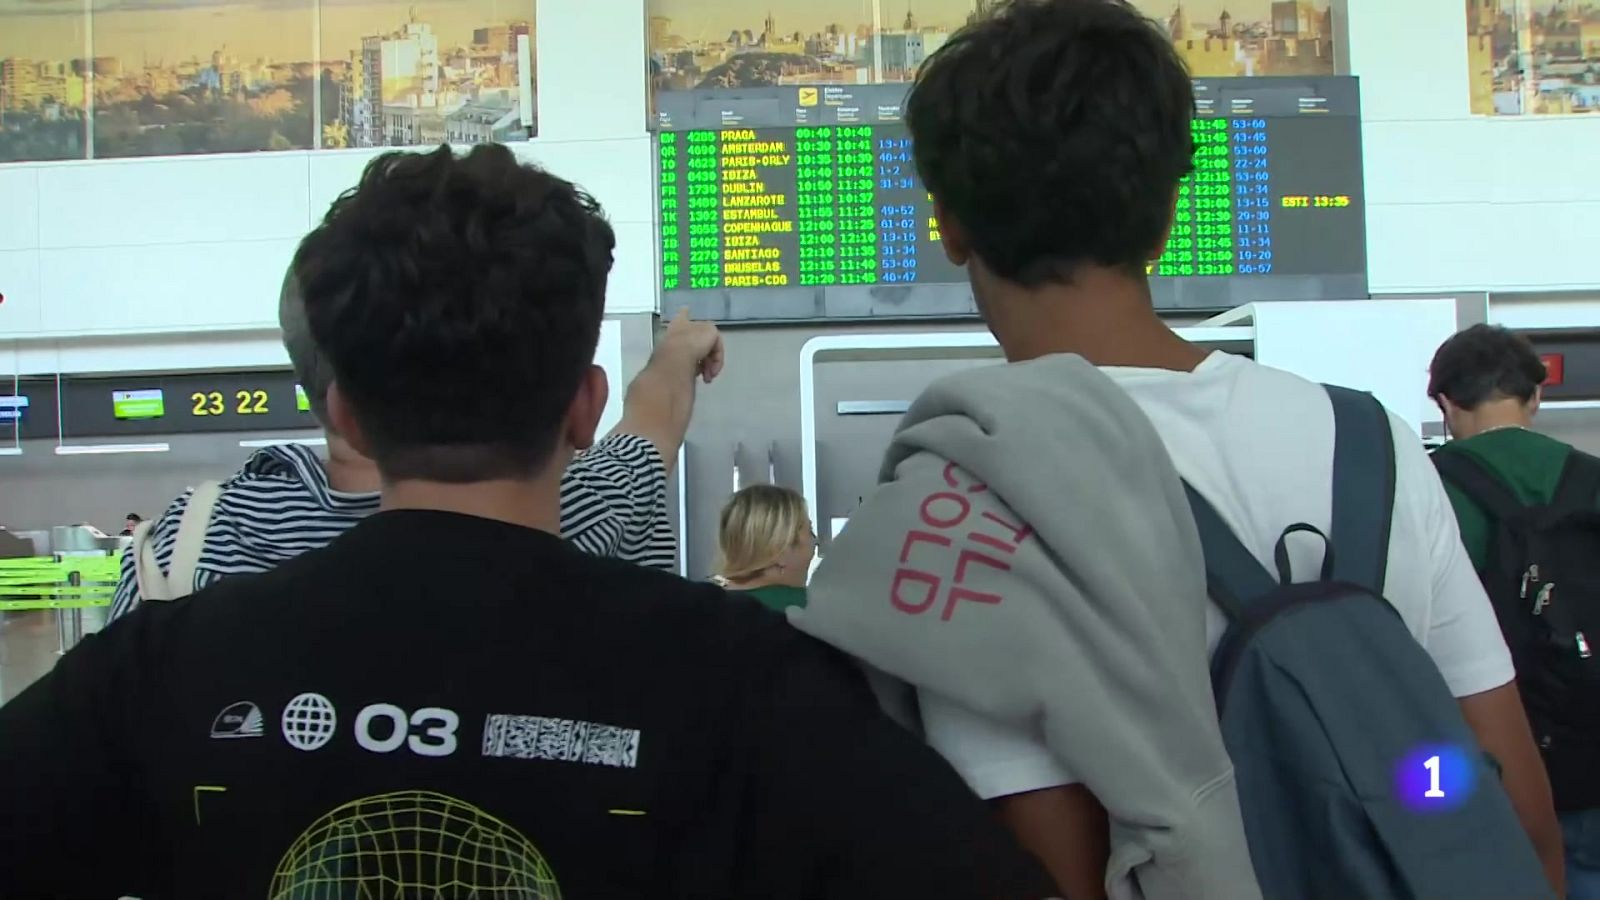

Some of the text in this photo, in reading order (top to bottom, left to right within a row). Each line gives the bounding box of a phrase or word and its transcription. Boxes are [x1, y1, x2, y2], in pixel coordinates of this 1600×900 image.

[1191, 119, 1227, 130] 11:45
[721, 130, 755, 141] PRAGA
[836, 126, 871, 137] 10:40
[661, 146, 676, 157] QR
[722, 142, 784, 154] AMSTERDAM
[796, 141, 831, 151] 10:30
[836, 140, 871, 150] 10:41
[662, 159, 675, 169] TO
[722, 156, 790, 167] PARIS-ORLY
[722, 170, 756, 180] IBIZA
[797, 167, 831, 178] 10:40
[838, 166, 872, 177] 10:42
[880, 166, 900, 175] 1-2
[1195, 172, 1230, 182] 12:15
[662, 186, 676, 196] FR
[722, 182, 763, 193] DUBLIN
[1195, 184, 1229, 195] 12:20
[662, 199, 677, 209] FR
[723, 195, 784, 207] LANZAROTE
[798, 193, 832, 204] 11:10
[838, 193, 873, 203] 10:37
[1195, 198, 1230, 208] 13:00
[1237, 198, 1269, 207] 13-15
[1282, 196, 1309, 208] ESTI
[1314, 196, 1350, 207] 13:35
[662, 212, 676, 222] TK
[723, 209, 778, 220] ESTAMBUL
[838, 206, 874, 217] 11:20
[1196, 211, 1231, 222] 12:30
[723, 221, 792, 233] COPENHAGUE
[799, 220, 833, 231] 12:00
[839, 220, 874, 230] 11:25
[1170, 224, 1269, 235] :10 12:35 11-11
[724, 236, 759, 246] IBIZA
[800, 234, 834, 244] 12:00
[840, 232, 875, 243] 12:10
[1197, 238, 1232, 248] 12:45
[664, 252, 678, 261] FR
[690, 250, 719, 261] 2270
[724, 248, 780, 260] SANTIAGO
[800, 247, 834, 257] 12:10
[840, 246, 875, 257] 11:35
[724, 262, 780, 273] BRUSELAS
[800, 260, 834, 271] 12:15
[840, 259, 875, 270] 11:40
[1159, 264, 1193, 275] 13:45
[1198, 264, 1233, 274] 13:10
[664, 278, 678, 289] AF
[690, 277, 719, 288] 1417
[725, 275, 787, 286] PARIS-CDG
[800, 274, 835, 285] 12:20
[840, 273, 876, 284] 11:45
[190, 390, 269, 416] 23 22
